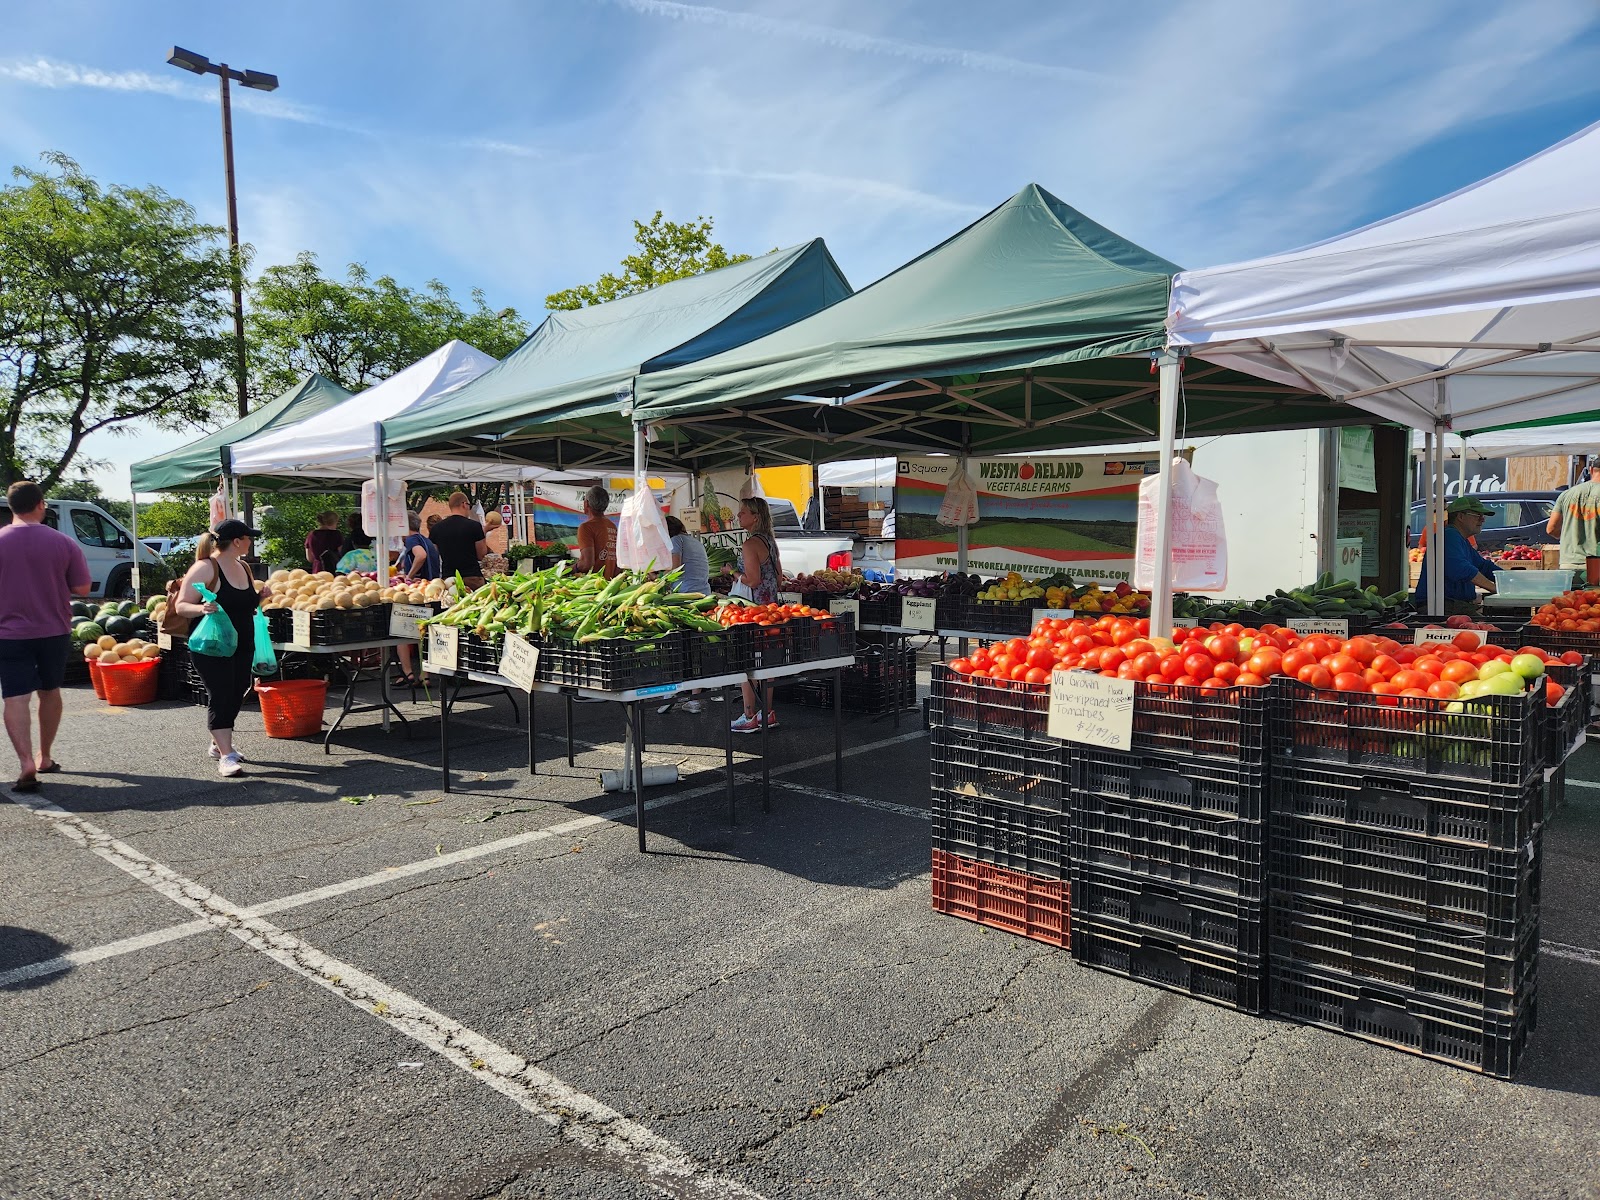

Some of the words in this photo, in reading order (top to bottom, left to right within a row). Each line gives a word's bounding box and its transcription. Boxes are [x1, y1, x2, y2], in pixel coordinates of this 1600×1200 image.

[912, 464, 948, 474] Square
[541, 488, 560, 496] Square
[986, 482, 1038, 492] VEGETABLE
[1040, 482, 1071, 492] FARMS
[1426, 632, 1455, 640] Heirl
[512, 640, 529, 656] Sweet
[512, 650, 526, 664] Corn
[1054, 672, 1064, 686] Va
[1070, 675, 1099, 690] Grown
[1054, 688, 1110, 708] Vine-ripened
[1054, 703, 1104, 721] Tomatoes
